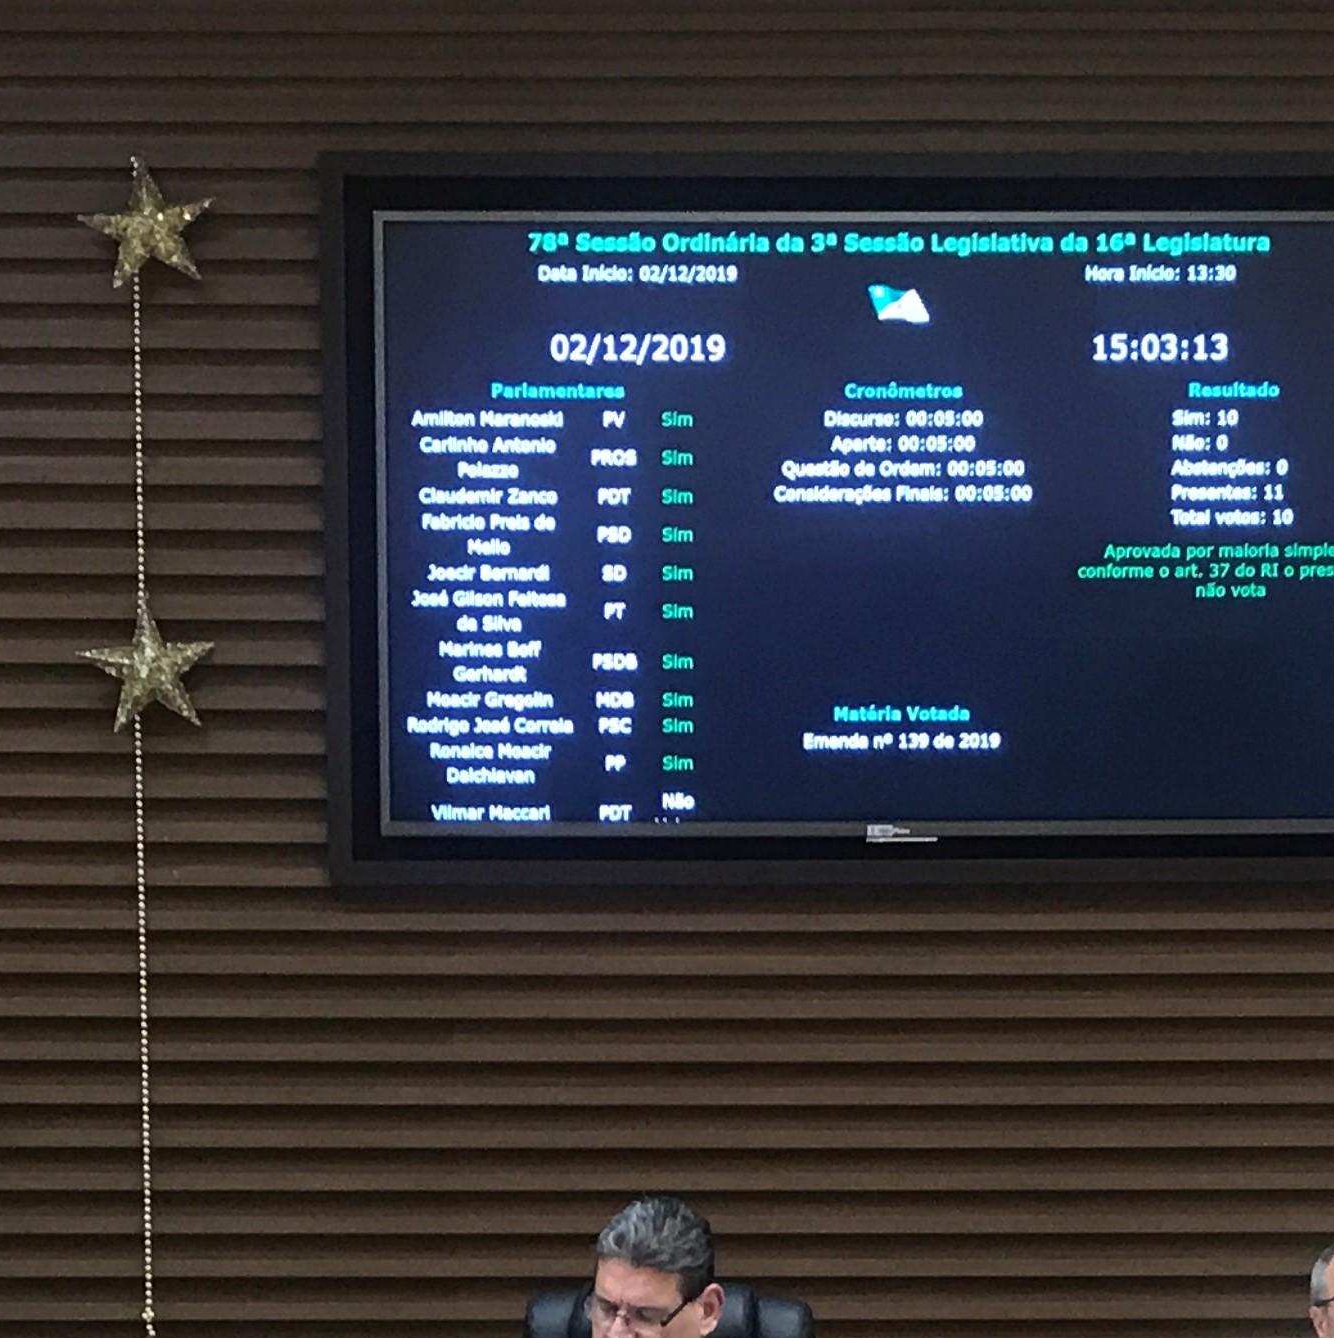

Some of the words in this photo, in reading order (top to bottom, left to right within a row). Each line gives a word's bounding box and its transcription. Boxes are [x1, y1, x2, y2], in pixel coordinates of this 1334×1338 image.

[527, 231, 569, 253] 78ª
[575, 231, 657, 253] Sessão
[661, 230, 770, 253] Ordinária
[775, 232, 805, 253] da
[810, 232, 838, 253] 3ª
[843, 231, 925, 253] Sessão
[930, 232, 1054, 258] Legislativa
[1059, 232, 1089, 253] da
[1096, 232, 1137, 253] 16ª
[1142, 231, 1271, 257] Legislatura
[537, 264, 578, 283] Data
[581, 263, 633, 283] Início:
[638, 264, 738, 285] 02/12/2019
[1084, 264, 1125, 283] Hora
[1128, 263, 1181, 283] Início:
[1187, 264, 1237, 282] 13:30
[550, 332, 726, 366] 02/12/2019
[1092, 332, 1229, 362] 15:03:13
[491, 381, 626, 399] Parlamentares
[844, 381, 963, 399] Cronômetros
[1188, 381, 1280, 398] Resultado
[410, 409, 476, 428] Amilton
[602, 410, 626, 429] PV
[661, 411, 694, 427] Sim
[823, 410, 900, 428] Discurso:
[905, 409, 984, 428] 00:05:00
[1171, 409, 1211, 427] Sim:
[1217, 408, 1239, 427] 10
[419, 435, 489, 454] Carlinho
[491, 436, 557, 455] Antonio
[830, 434, 893, 456] Aparte:
[897, 434, 976, 453] 00:05:00
[1171, 433, 1211, 452] Não:
[1215, 433, 1229, 452] 0
[590, 448, 638, 467] PROS
[661, 449, 694, 466] Sim
[781, 459, 851, 481] Questão
[853, 459, 876, 478] de
[878, 459, 942, 478] Ordem:
[946, 459, 1025, 478] 00:05:00
[1170, 458, 1271, 479] Abstenções:
[1275, 458, 1289, 476] 0
[418, 486, 504, 505] Claudemir
[597, 487, 632, 506] PDT
[662, 488, 694, 505] Sim
[773, 484, 892, 506] Considerações
[895, 484, 949, 503] Finais:
[954, 484, 1033, 502] 00:05:00
[1171, 483, 1258, 502] Presentes:
[1263, 483, 1284, 501] 11
[533, 513, 556, 532] de
[1170, 508, 1211, 526] Total
[1214, 508, 1267, 526] votos:
[1272, 508, 1294, 526] 10
[596, 525, 632, 544] PSD
[662, 526, 694, 543] Sim
[467, 537, 511, 556] Mello
[1103, 542, 1181, 562] Aprovada
[1186, 545, 1215, 561] por
[1218, 542, 1280, 559] maioria
[479, 563, 551, 582] Bernardi
[601, 564, 628, 582] SD
[662, 565, 694, 581] Sim
[1077, 562, 1155, 579] conforme
[1158, 565, 1170, 579] o
[1174, 563, 1203, 579] art.
[1209, 562, 1230, 579] 37
[1234, 562, 1256, 578] do
[1260, 562, 1279, 578] RI
[1283, 565, 1295, 578] o
[410, 588, 449, 608] José
[452, 589, 504, 608] Gilson
[1195, 581, 1226, 598] não
[1230, 582, 1267, 598] vota
[603, 601, 627, 620] PT
[662, 603, 694, 619] Sim
[456, 614, 478, 633] da
[482, 614, 523, 633] Silva
[592, 652, 639, 671] PSDB
[662, 653, 694, 670] Sim
[426, 690, 482, 709] Moacir
[484, 690, 554, 713] Gregolin
[595, 691, 635, 709] MDB
[662, 692, 694, 708] Sim
[833, 704, 902, 722] Matéria
[906, 704, 971, 722] Votada
[406, 716, 470, 738] Rodrigo
[473, 715, 511, 735] José
[598, 716, 632, 735] PSC
[662, 717, 694, 734] Sim
[497, 742, 552, 760] Moacir
[803, 732, 870, 751] Emenda
[872, 732, 894, 750] nº
[898, 732, 930, 750] 139
[932, 732, 955, 750] de
[958, 732, 1002, 750] 2019
[604, 754, 627, 772] PP
[662, 755, 694, 771] Sim
[662, 791, 695, 810] Não
[430, 804, 486, 821] Vilmar
[488, 804, 551, 822] Maccari
[598, 804, 633, 822] PDT
